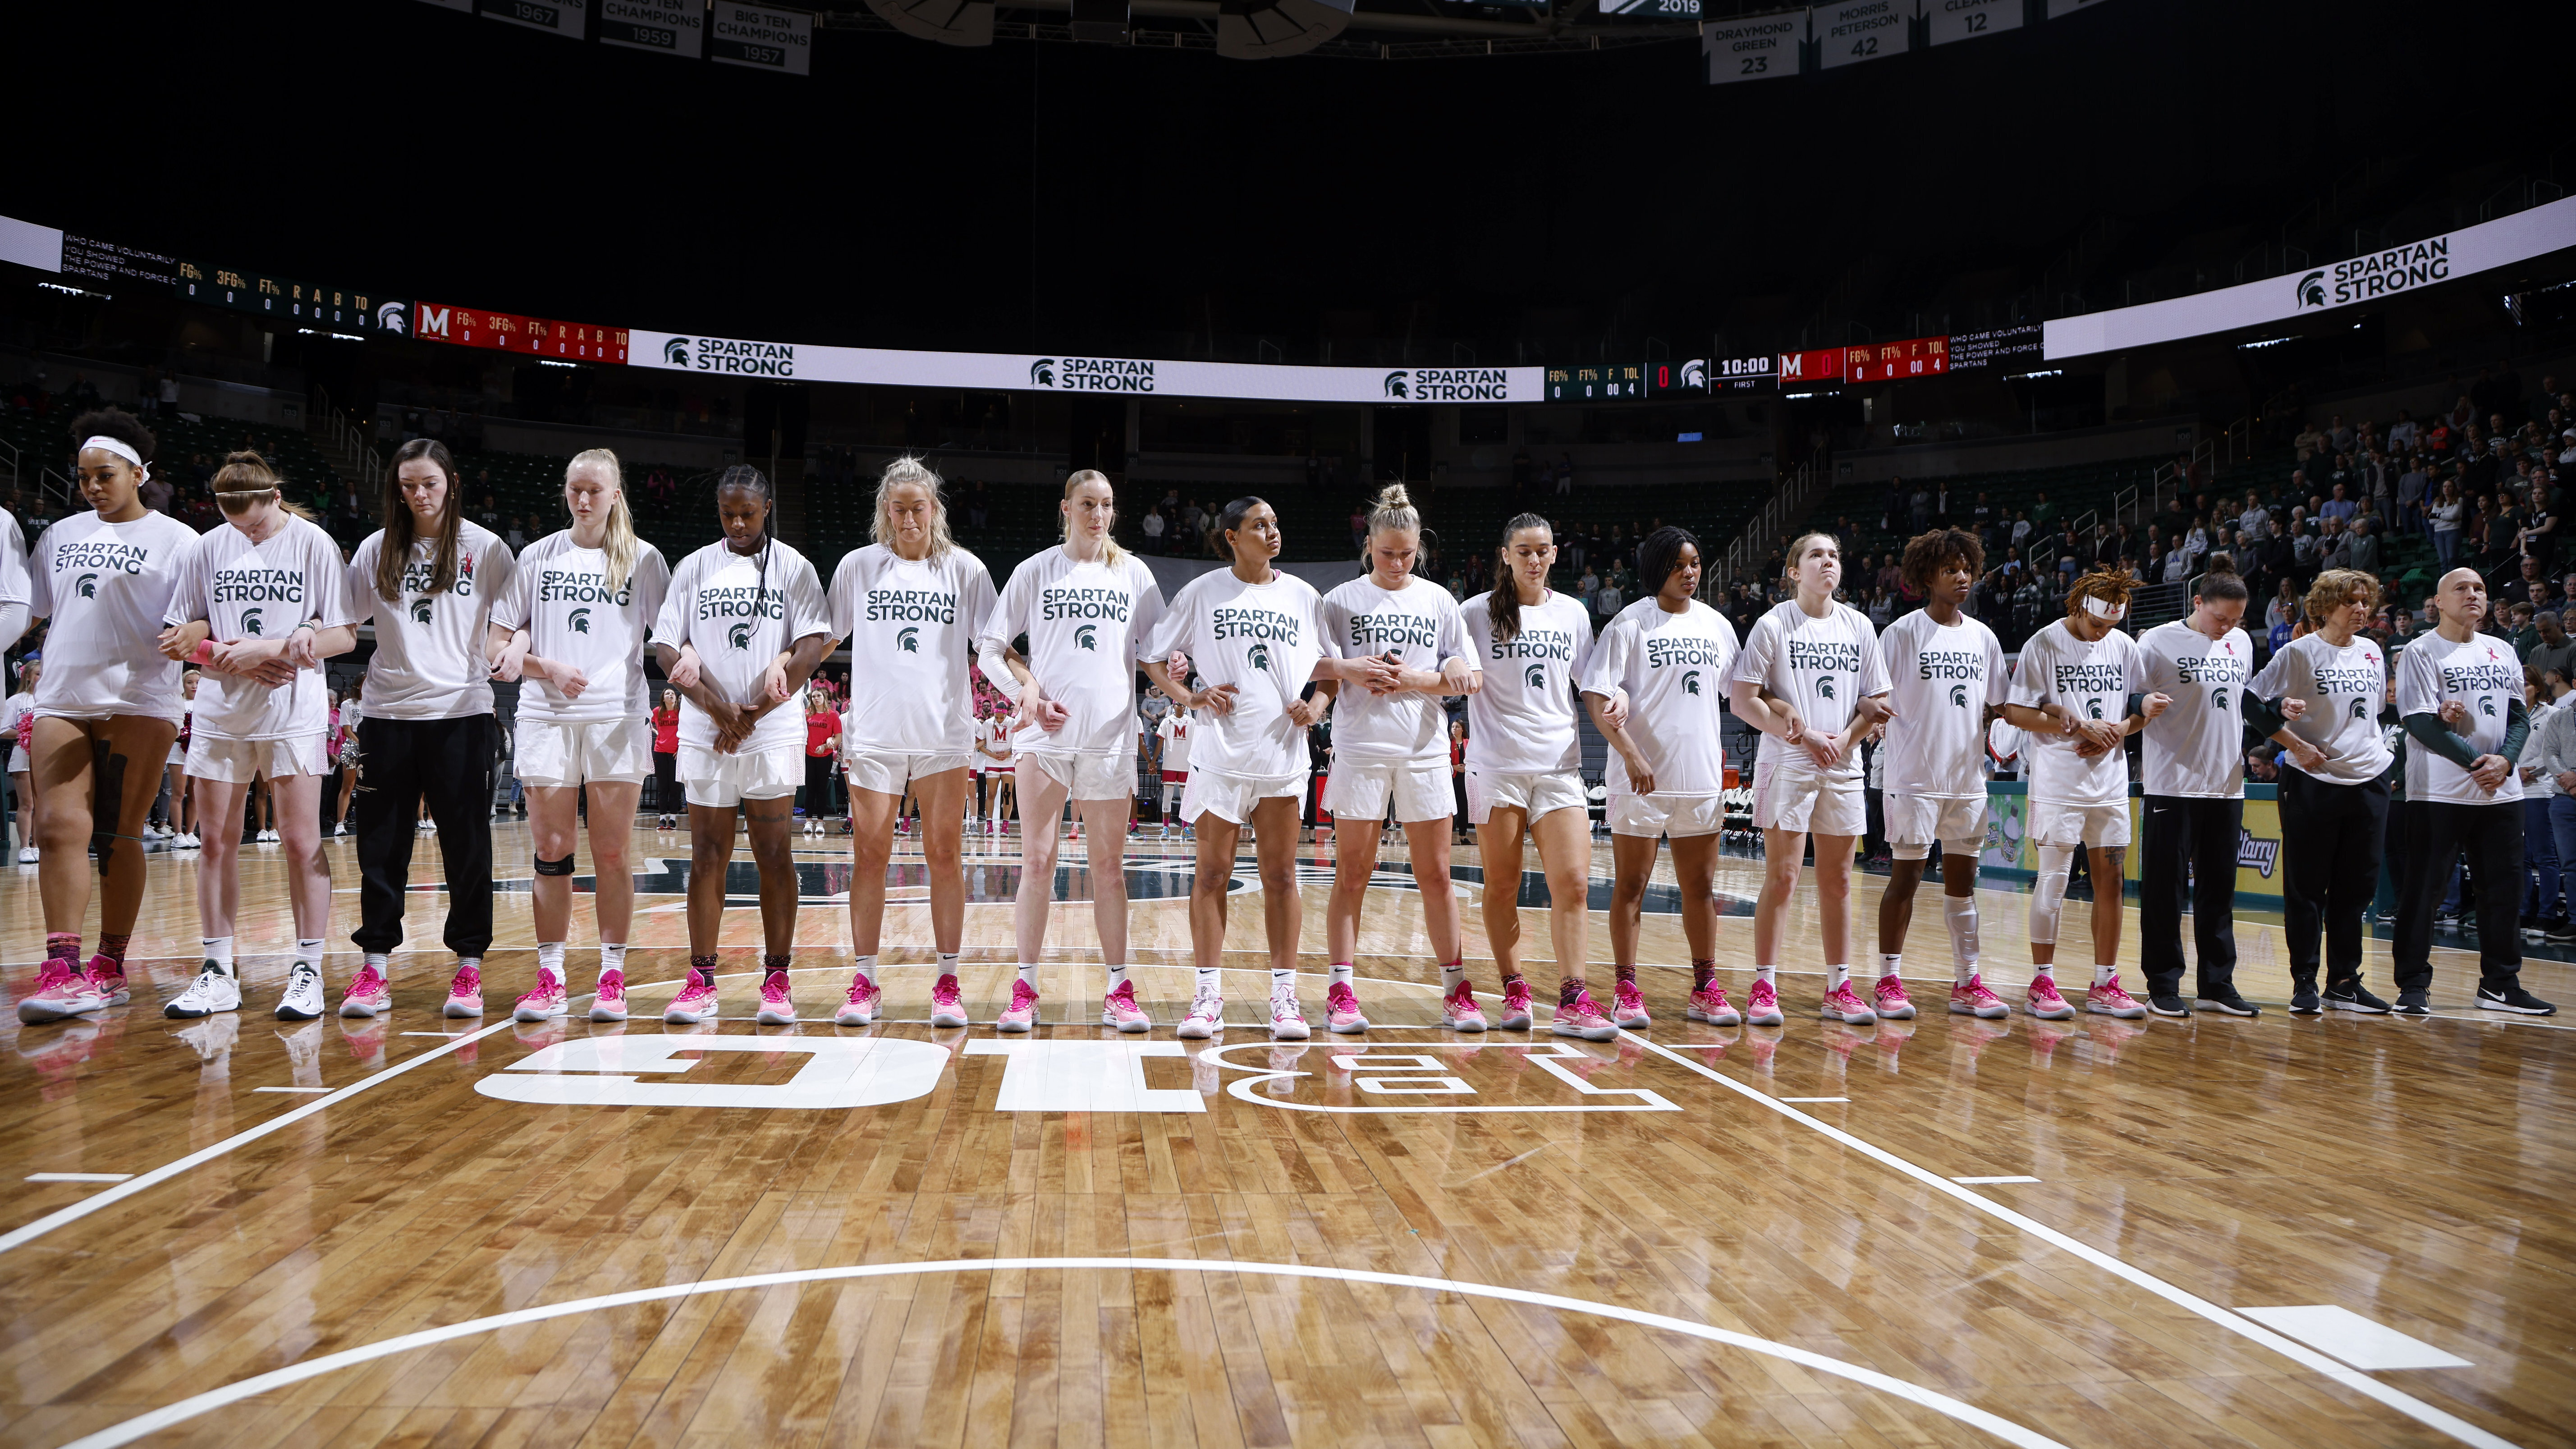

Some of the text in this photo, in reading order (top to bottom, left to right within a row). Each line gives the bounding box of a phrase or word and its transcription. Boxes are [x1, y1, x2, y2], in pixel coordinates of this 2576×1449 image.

[515, 3, 554, 23] 1967
[606, 3, 700, 28] CHAMPIONS
[1659, 0, 1700, 13] 2019
[1840, 1, 1889, 21] MORRIS
[735, 10, 790, 28] BIG TEN
[1831, 14, 1898, 37] PETERSON
[1965, 13, 1987, 32] 12
[632, 27, 671, 44] 1959
[717, 22, 807, 46] CHAMPIONS
[1715, 22, 1792, 40] DRAYMOND
[1733, 38, 1776, 51] GREEN
[1851, 37, 1877, 56] 42
[743, 46, 779, 62] 1957
[1741, 56, 1767, 73] 23
[64, 245, 125, 264] YOU SHOWED
[65, 234, 176, 265] WHO CAME VOLUNTARILY
[2334, 237, 2448, 282] SPARTAN
[63, 264, 110, 280] SPARTANS
[64, 254, 82, 265] THE
[84, 259, 117, 271] POWER
[119, 267, 137, 276] AND
[140, 271, 169, 284] FORCE
[180, 262, 368, 310] FG% 3FG% FT% R A B TO
[2335, 257, 2448, 303] STRONG
[189, 284, 365, 325] 0 0 0 0 0 0 0
[420, 304, 450, 336] M
[457, 312, 627, 345] FG% 3FG% FT% R A B TO
[1950, 324, 2043, 343] WHO CAME VOLUNTARILY
[464, 330, 624, 360] 0 0 0 0 0 0 0
[698, 338, 793, 359] SPARTAN
[1850, 341, 1944, 363] FG% FT% F TOL
[1966, 349, 1993, 360] POWER
[1995, 347, 2011, 356] AND
[2012, 343, 2038, 353] FORCE
[1968, 340, 2000, 351] SHOWED
[697, 353, 793, 376] STRONG
[1062, 358, 1154, 375] SPARTAN
[1722, 357, 1769, 375] 10:00
[1781, 353, 1802, 377] M
[1822, 354, 1832, 376] 0
[1856, 358, 1940, 380] 0 0 00 4
[1949, 358, 1988, 371] SPARTANS
[1062, 372, 1154, 391] STRONG
[1416, 370, 1506, 383] SPARTAN
[1549, 367, 1639, 382] FG% FT% F TOL
[1659, 366, 1668, 388] 0
[1416, 384, 1507, 399] STRONG
[1554, 382, 1634, 398] 0 0 00 4
[57, 543, 148, 561] SPARTAN
[55, 554, 142, 575] STRONG
[216, 569, 303, 585] SPARTAN
[215, 585, 303, 603] STRONG
[540, 585, 629, 606] STRONG
[699, 587, 784, 604] SPARTAN
[867, 590, 955, 608] SPARTAN
[1043, 588, 1128, 607] SPARTAN
[700, 601, 783, 620] STRONG
[866, 605, 954, 624] STRONG
[1044, 602, 1127, 622] STRONG
[1214, 609, 1298, 632] SPARTAN
[1350, 614, 1435, 632] SPARTAN
[1214, 622, 1297, 647] STRONG
[1352, 627, 1434, 647] STRONG
[1491, 630, 1571, 646] SARTAN
[1492, 643, 1570, 661] STRONG
[1647, 638, 1719, 654] SPARTAN
[1789, 640, 1860, 657] SPARTAN
[1649, 650, 1719, 669] STRONG
[1789, 654, 1859, 673] STRONG
[1919, 652, 1984, 667] SPARTAN
[2177, 657, 2245, 672] SPARTAN
[1920, 665, 1983, 682] STRONG
[2056, 664, 2122, 678] SPARTAN
[2179, 669, 2246, 685] STRONG
[2315, 669, 2380, 681] SPARTAN
[2443, 665, 2511, 679] SPARTAN
[2057, 678, 2122, 692] STRONG
[2317, 680, 2380, 695] STRONG
[2447, 676, 2510, 693] STRONG
[993, 725, 1007, 741] M
[1173, 724, 1187, 738] M
[2237, 829, 2277, 876] tarry
